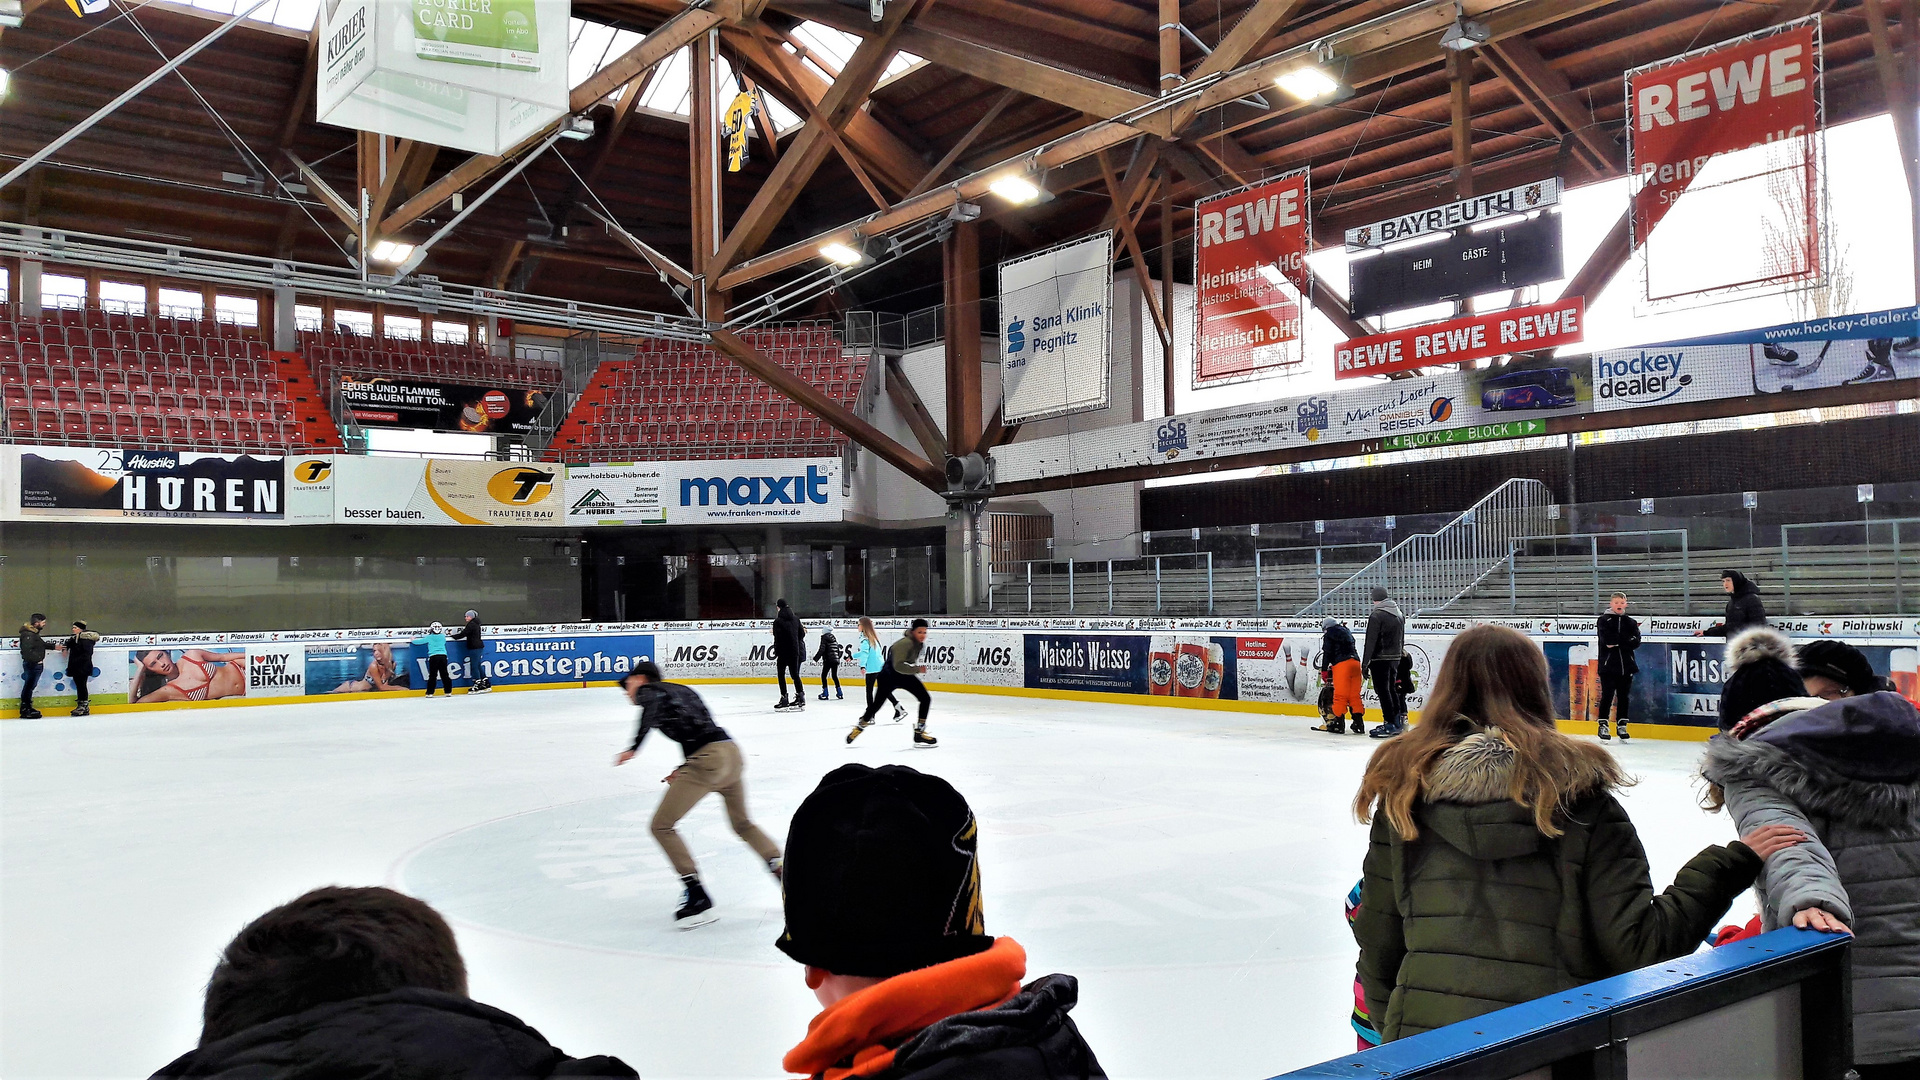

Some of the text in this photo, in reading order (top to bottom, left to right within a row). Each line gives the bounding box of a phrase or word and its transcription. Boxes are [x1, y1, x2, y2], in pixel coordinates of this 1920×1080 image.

[419, 9, 474, 30] CARD
[327, 6, 366, 64] KURIER
[1638, 44, 1806, 132] REWE
[1202, 188, 1301, 248] REWE
[1381, 190, 1515, 241] BAYREUTH
[1413, 258, 1433, 271] HEIM
[1033, 302, 1103, 332] Sana Klinik
[1033, 331, 1078, 353] Pegnitz
[1202, 324, 1264, 352] Heinisch
[1338, 308, 1578, 372] REWE REWE REWE
[1007, 358, 1026, 369] sana
[1599, 350, 1684, 380] hockey
[341, 382, 441, 397] FEUER UND FLAMME
[1600, 372, 1669, 399] dealer
[370, 392, 404, 403] BAUEN
[406, 395, 424, 404] MIT
[1297, 396, 1328, 416] GSB
[1343, 382, 1438, 426] Marcus Losert
[1200, 405, 1288, 425] Unternehmensgruppe GSB
[1379, 409, 1424, 421] OMNIBUS
[1157, 419, 1187, 440] GSB
[1379, 418, 1424, 431] REISEN
[1403, 422, 1523, 446] BLOCK 2 BLOCK 1
[97, 450, 124, 471] 25
[128, 454, 176, 470] Akustiks
[680, 465, 828, 506] maxit
[123, 510, 160, 518] besser
[344, 507, 425, 519] besser bauen.
[707, 509, 801, 517] www.franken-maxit.de
[1180, 620, 1221, 628] www.pio-24.de
[1236, 620, 1268, 628] Piotrowski
[1411, 621, 1466, 630] www.pio-24.de
[1651, 620, 1701, 630] Piotrowski
[1842, 620, 1903, 631] Piotrowski
[495, 640, 576, 652] Restaurant
[673, 645, 719, 661] MGS
[923, 646, 955, 664] MGS
[1039, 640, 1131, 670] Maisel's Weisse
[265, 654, 289, 665] MY
[977, 647, 1011, 665] MGS
[250, 665, 286, 676] NEW
[250, 675, 301, 687] BIKINI
